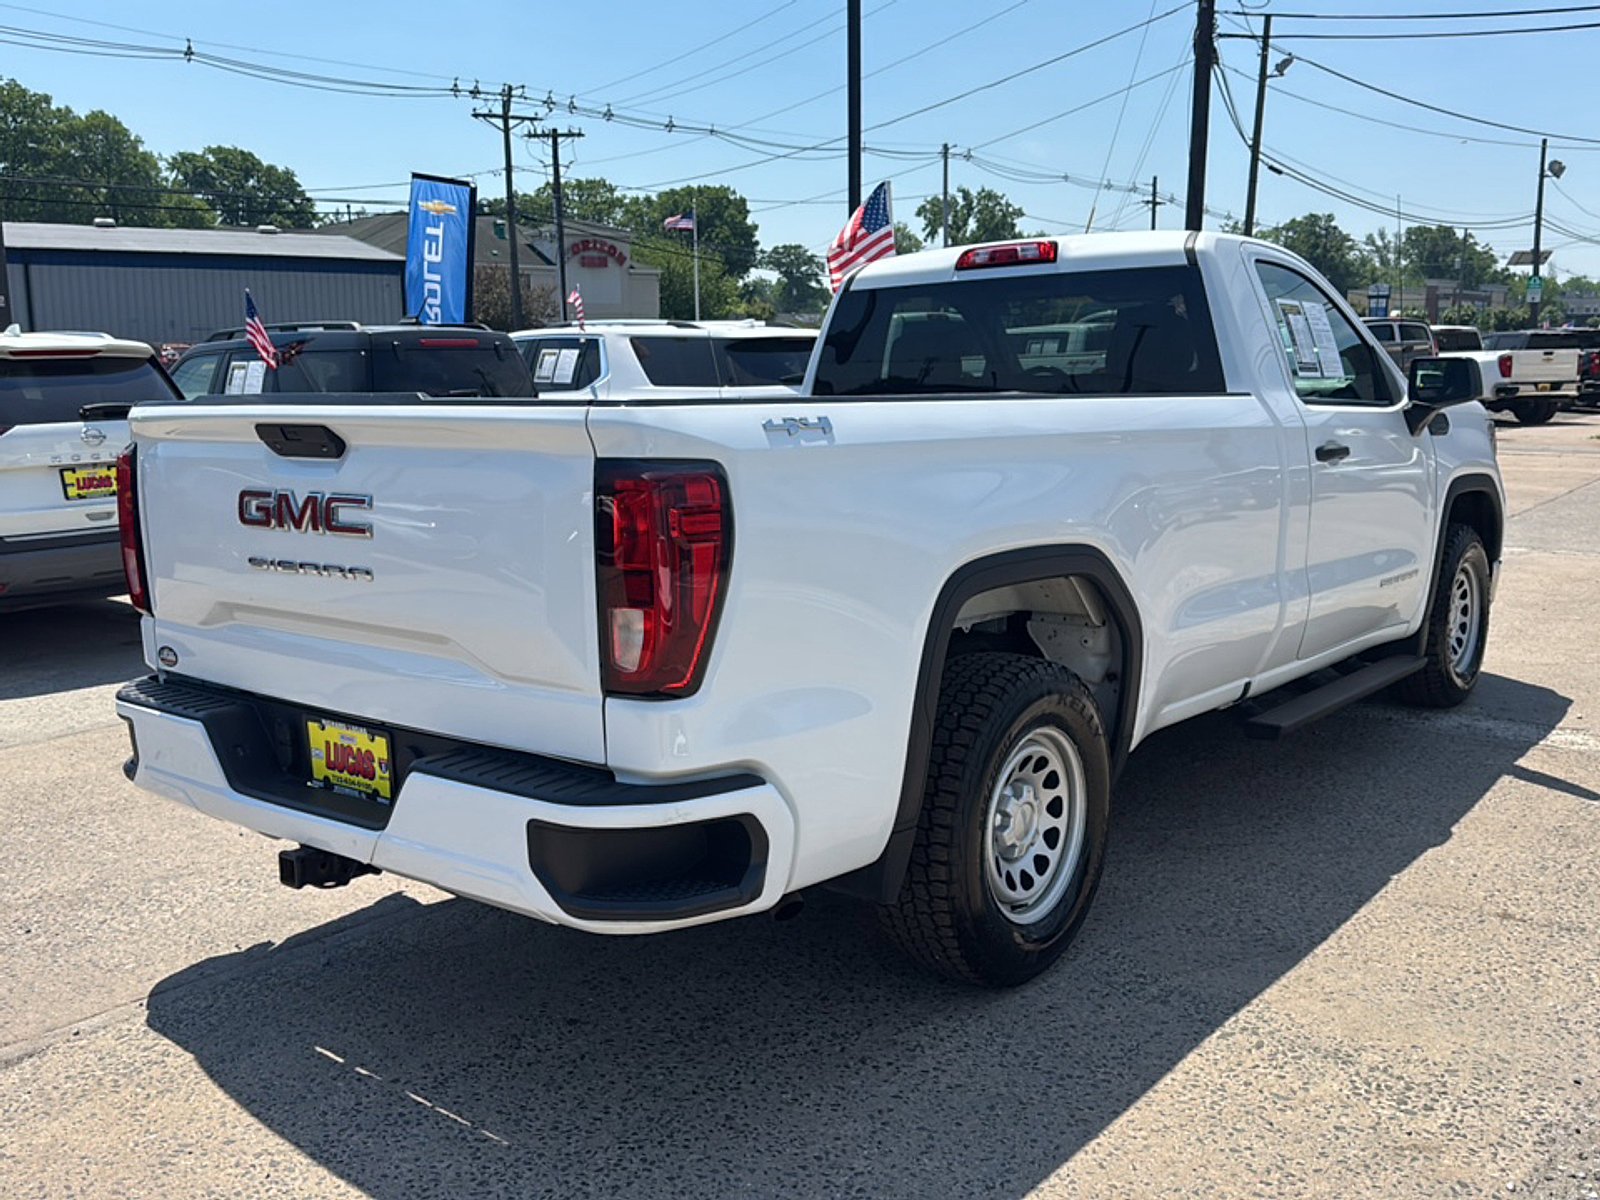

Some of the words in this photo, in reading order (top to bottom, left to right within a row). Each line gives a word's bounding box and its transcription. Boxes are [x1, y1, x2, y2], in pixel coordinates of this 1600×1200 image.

[76, 475, 113, 491] LUCAS
[238, 488, 373, 539] GMC
[248, 557, 374, 581] SIERRA
[325, 740, 376, 781] LUCAS
